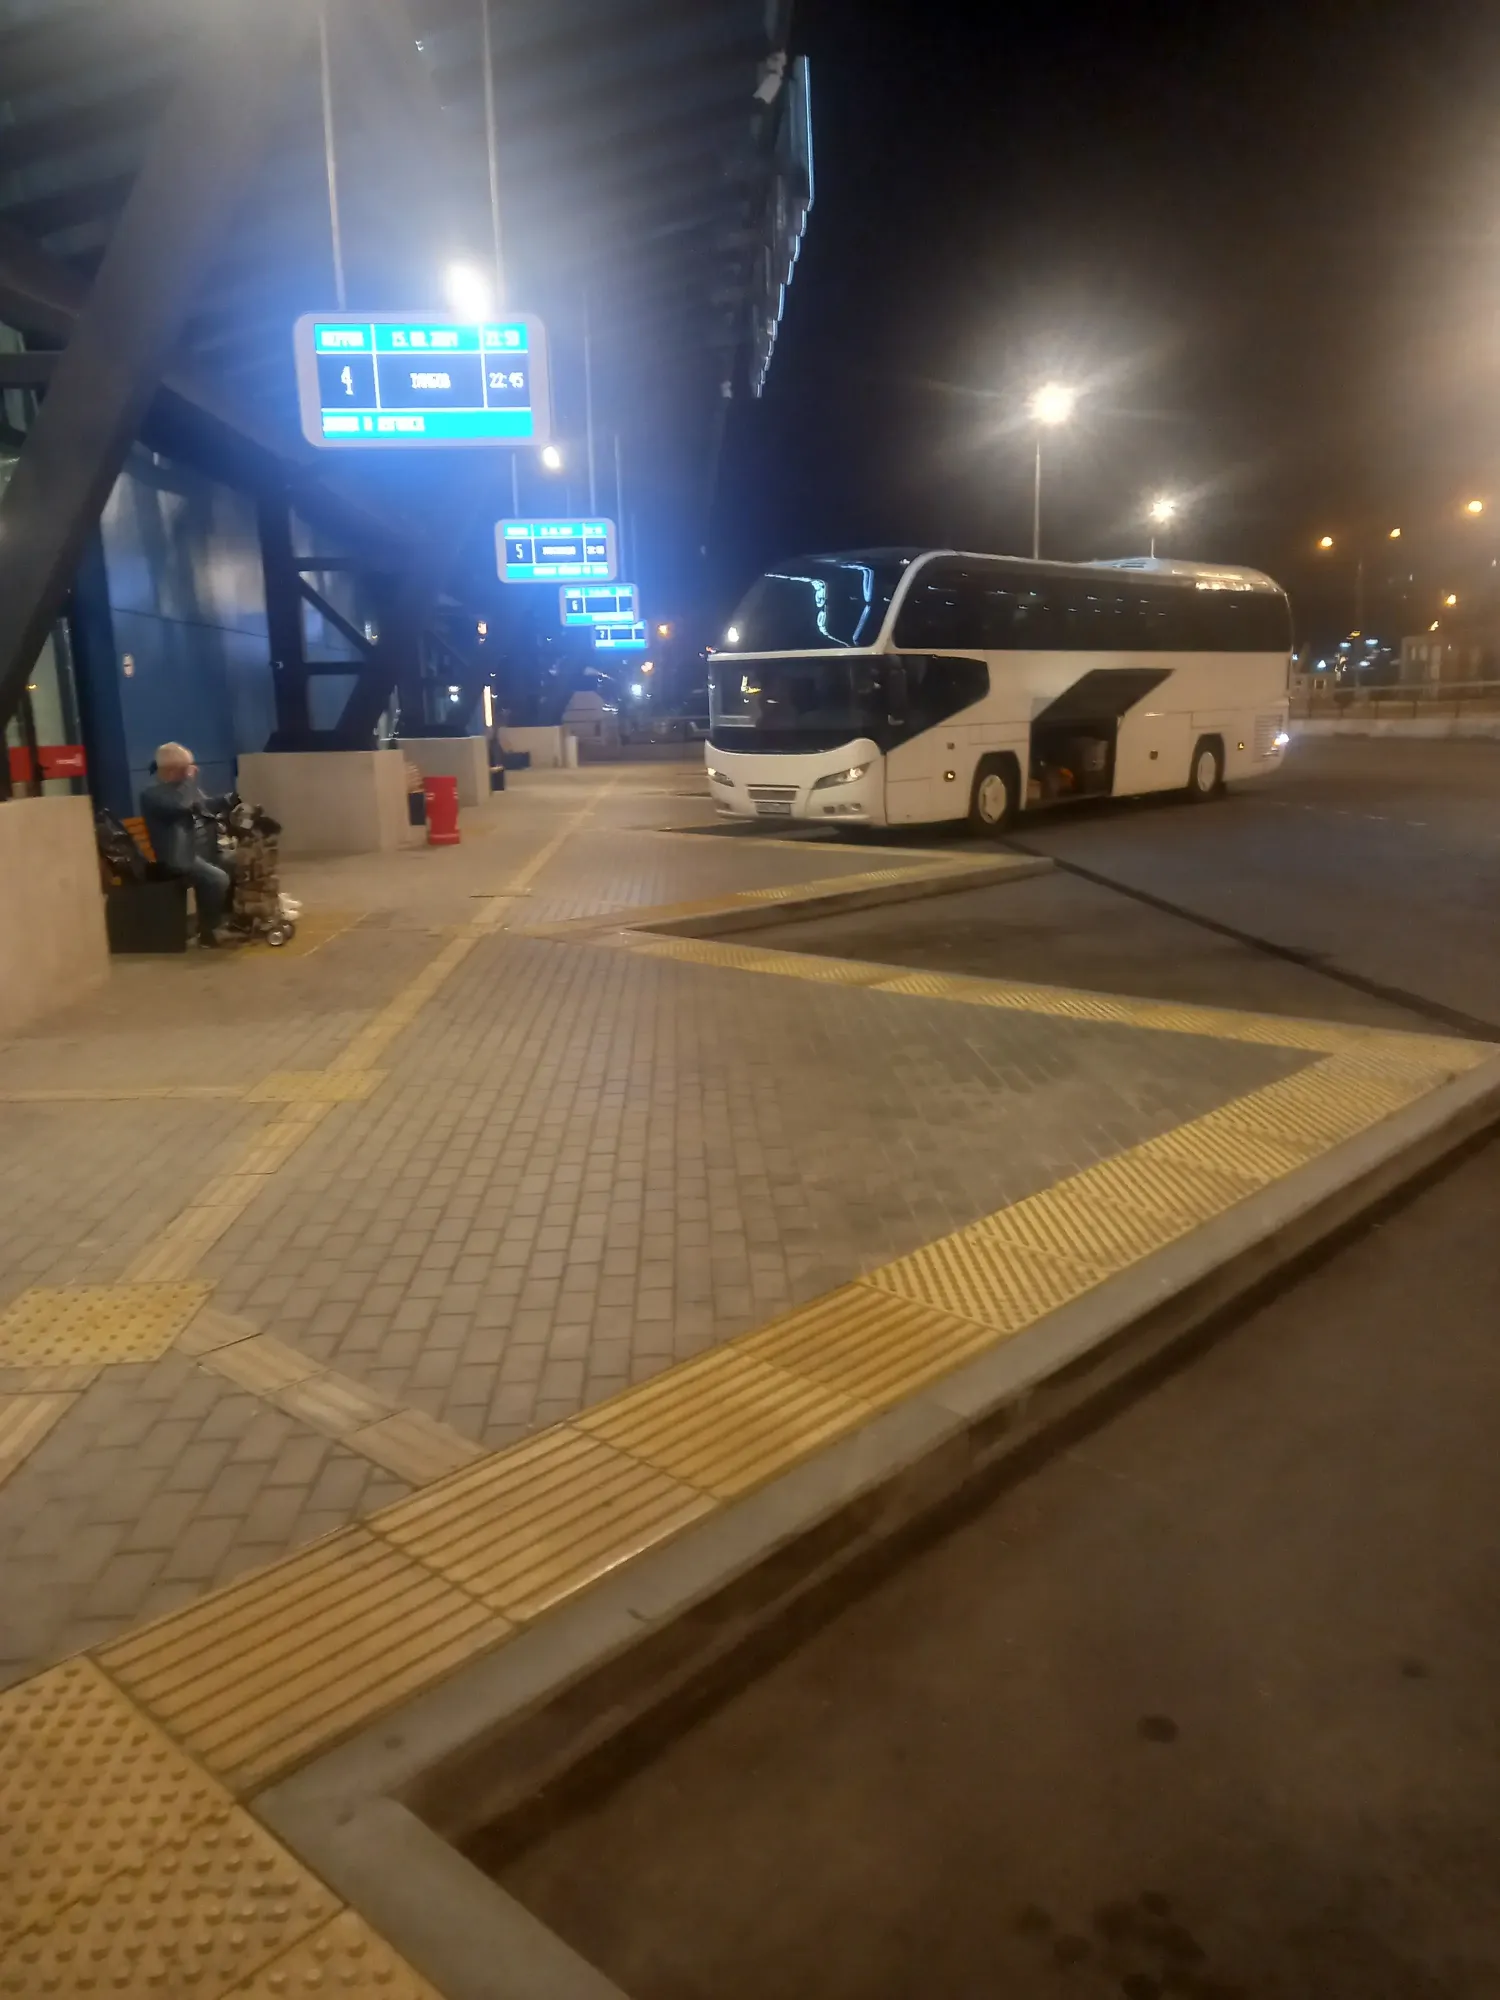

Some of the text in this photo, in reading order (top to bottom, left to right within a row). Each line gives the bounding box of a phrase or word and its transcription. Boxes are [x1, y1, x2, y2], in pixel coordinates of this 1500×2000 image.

[341, 366, 354, 396] 4
[489, 372, 524, 388] 22:45
[515, 543, 524, 560] 5
